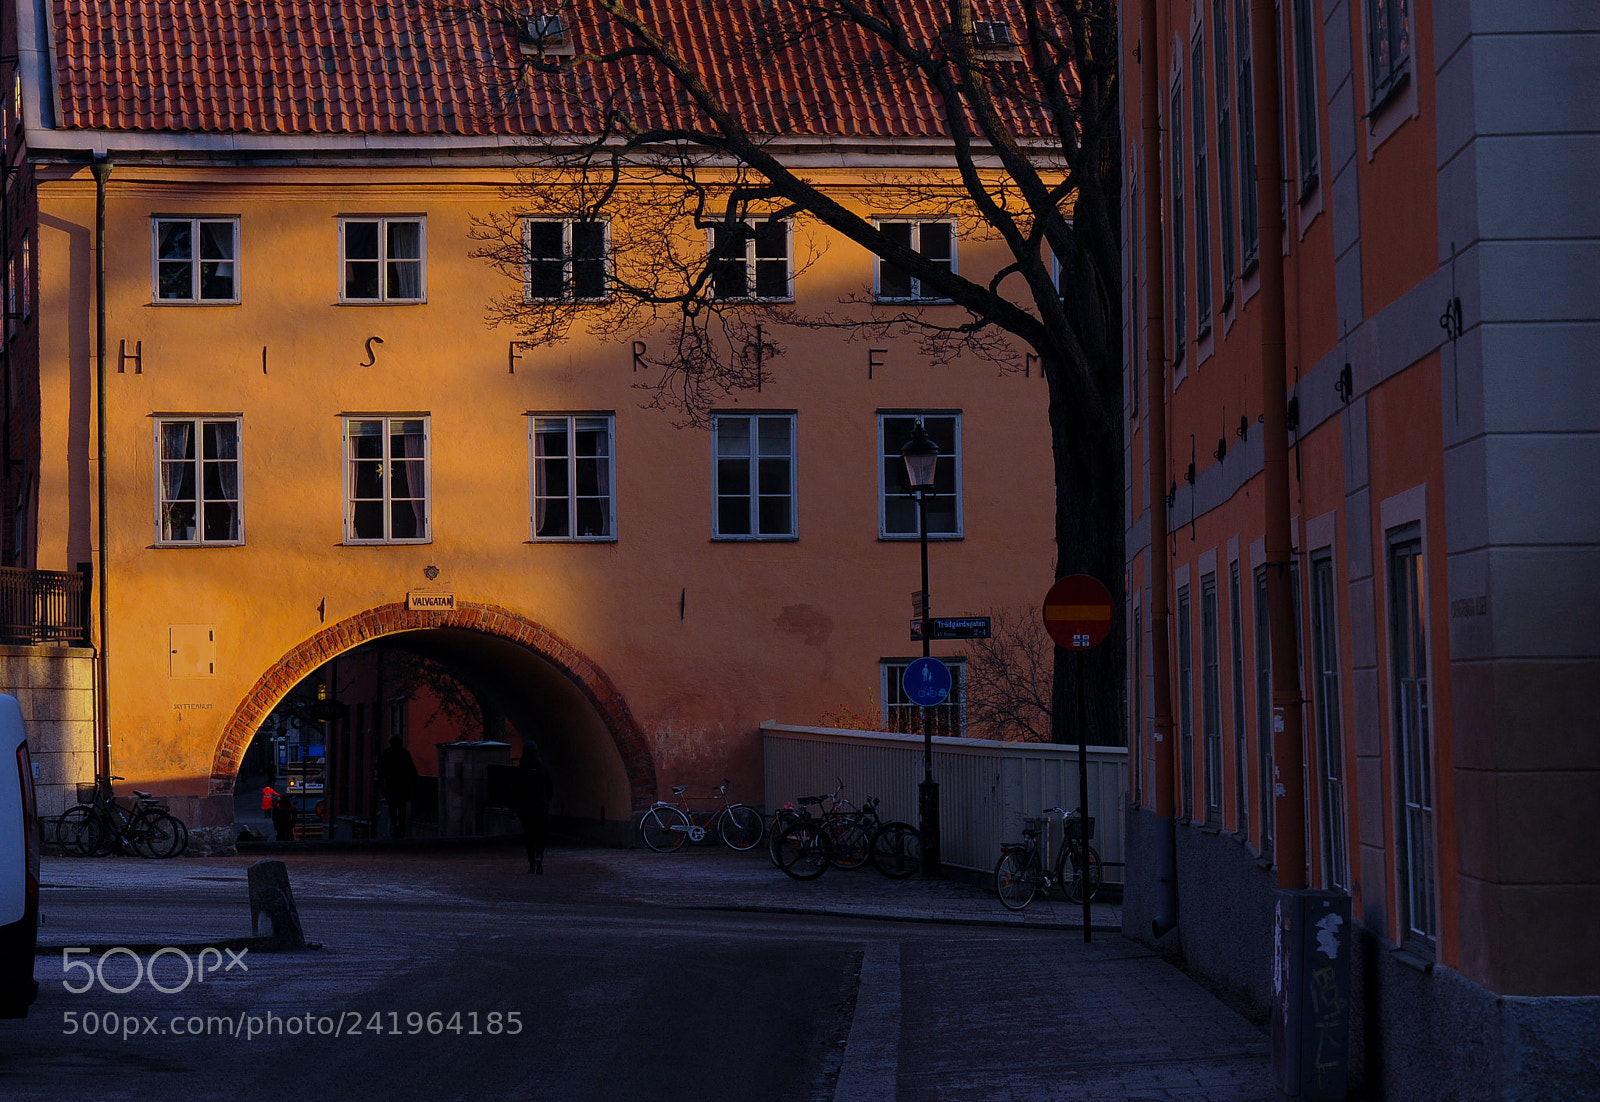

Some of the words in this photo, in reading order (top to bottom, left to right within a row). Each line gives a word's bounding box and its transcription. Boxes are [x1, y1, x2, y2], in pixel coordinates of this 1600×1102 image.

[118, 339, 142, 374] H
[360, 336, 384, 367] S
[633, 341, 648, 372] R
[869, 349, 888, 379] F
[411, 597, 452, 606] VALVGATAN
